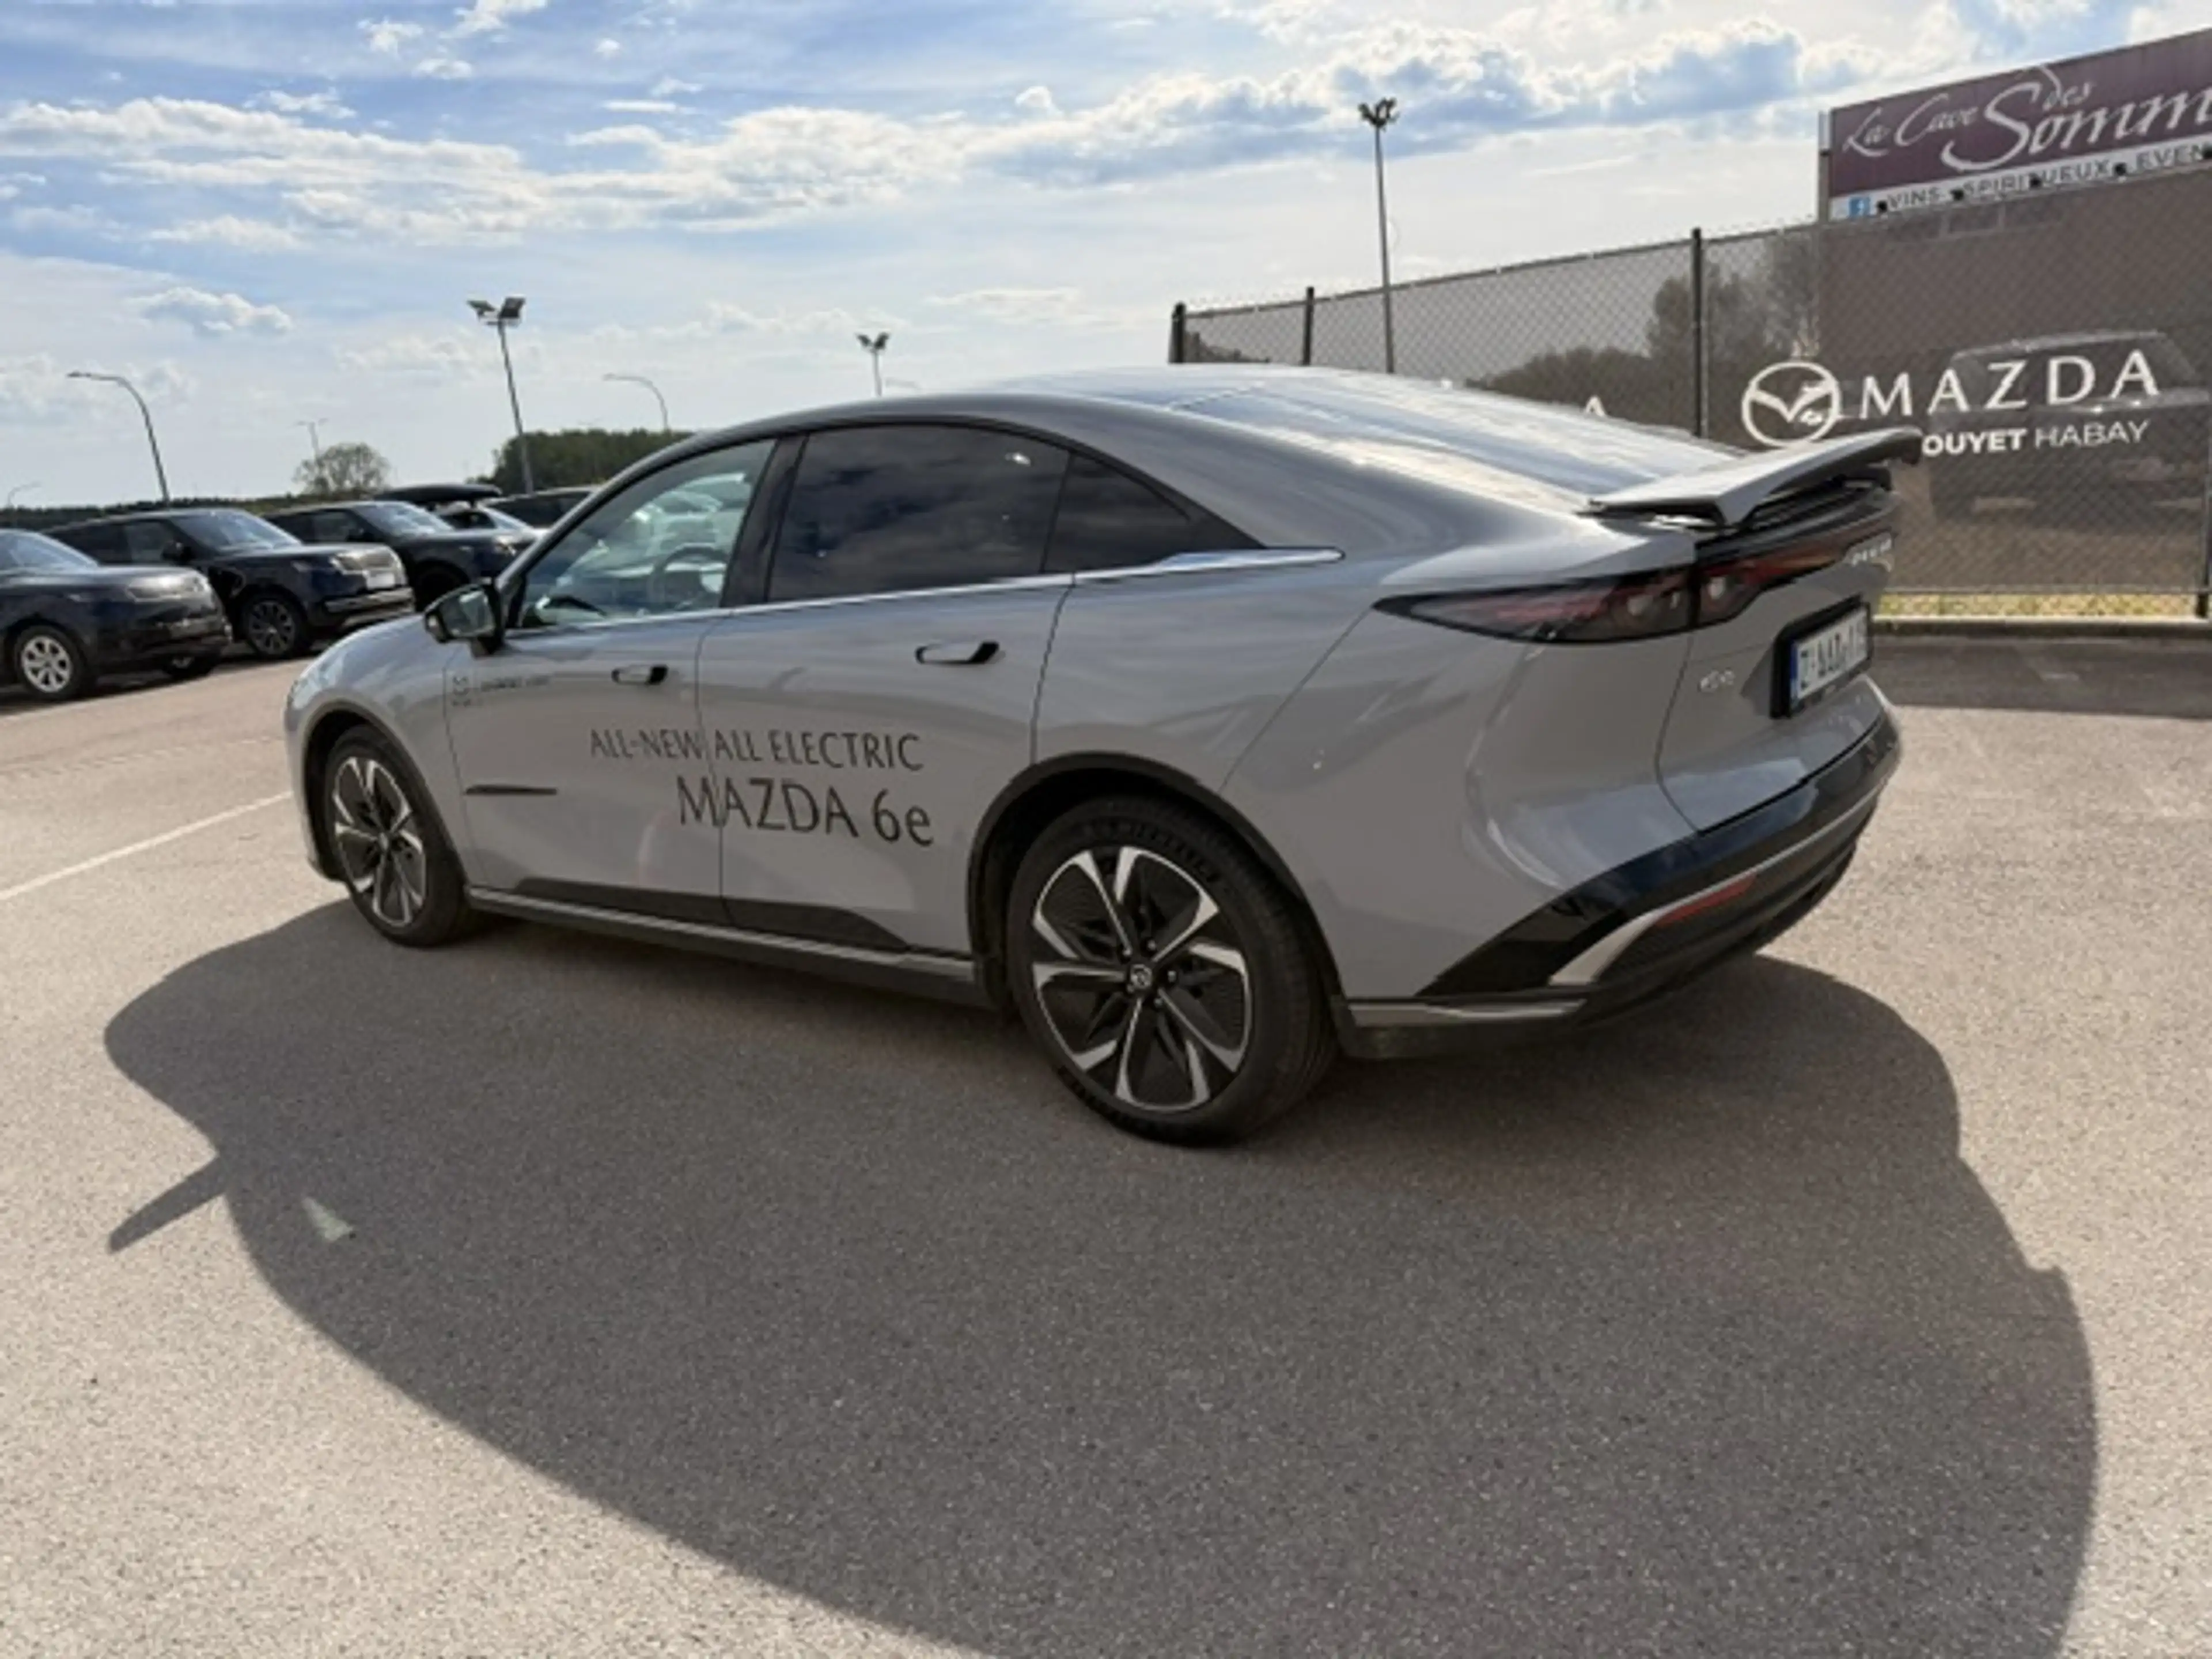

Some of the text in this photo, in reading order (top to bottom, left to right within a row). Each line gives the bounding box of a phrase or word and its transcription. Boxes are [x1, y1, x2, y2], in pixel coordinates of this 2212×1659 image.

[1842, 106, 1890, 157] La
[1887, 185, 1941, 210] VINS
[1963, 158, 2111, 194] SPIRIUEUX
[1859, 349, 2160, 419] MAZDA
[1922, 419, 2151, 457] OUYET HABAY
[590, 728, 923, 771] ALL-NEW ALL ELECTRIC
[677, 775, 934, 847] MAZDA 6e
